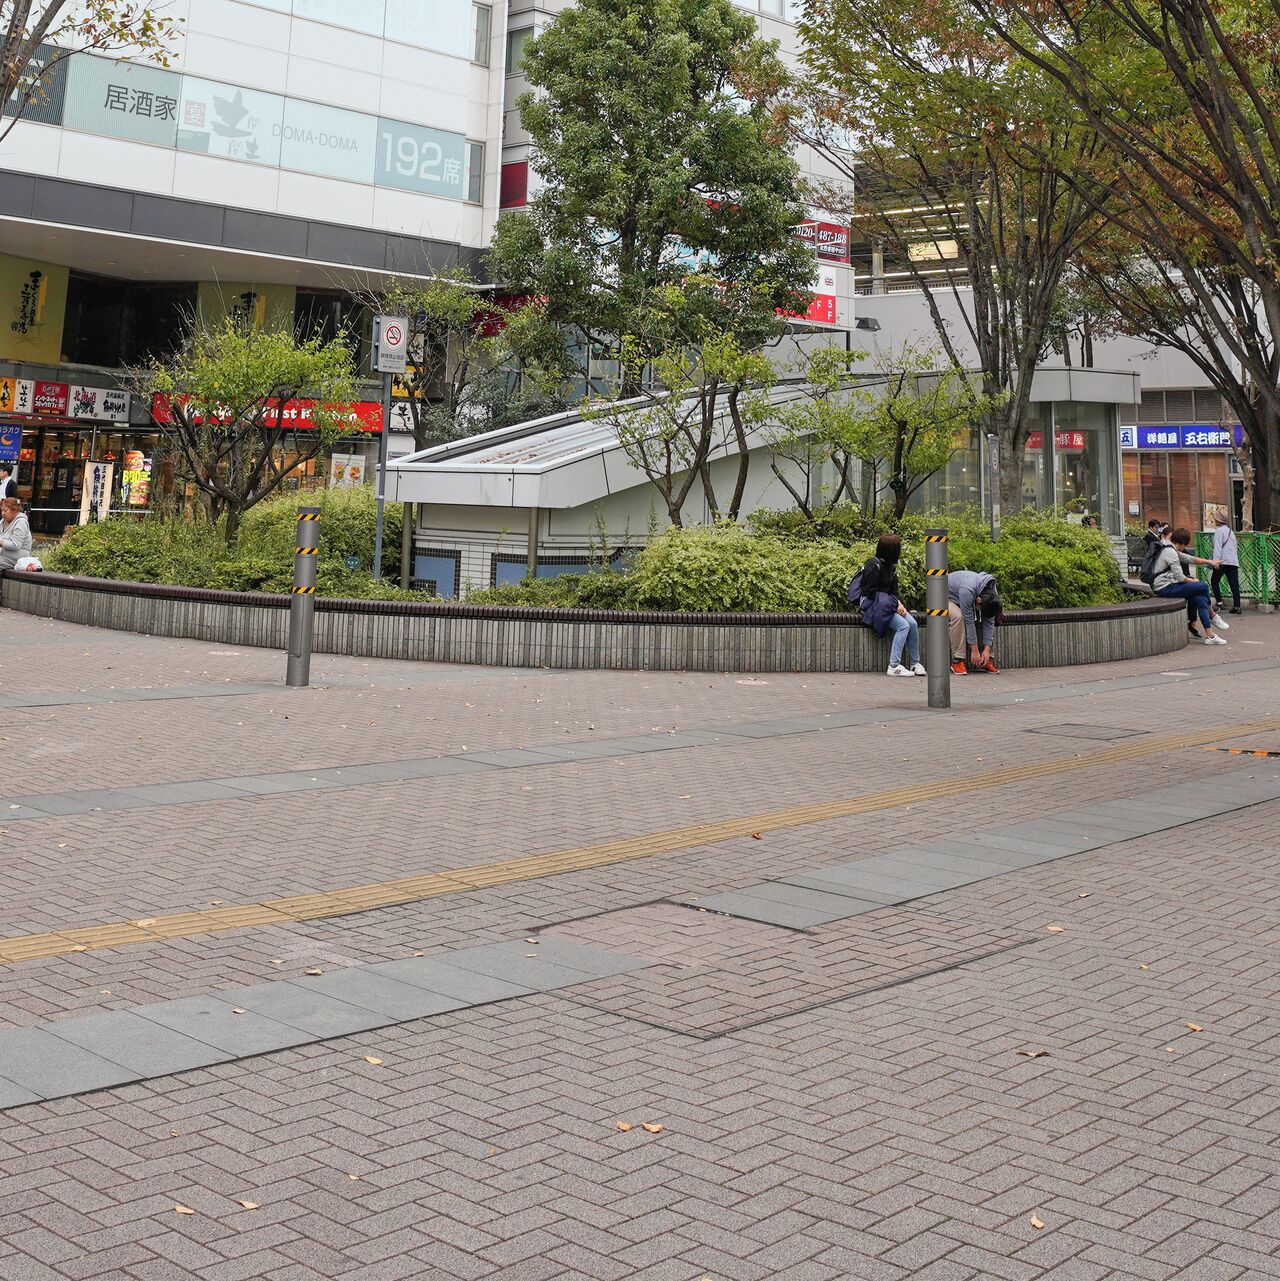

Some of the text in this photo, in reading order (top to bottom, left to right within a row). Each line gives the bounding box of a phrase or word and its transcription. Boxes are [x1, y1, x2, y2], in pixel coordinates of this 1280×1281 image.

[103, 84, 177, 122] 居酒家
[271, 123, 358, 153] DOMA-DOMA
[382, 131, 460, 184] 192席
